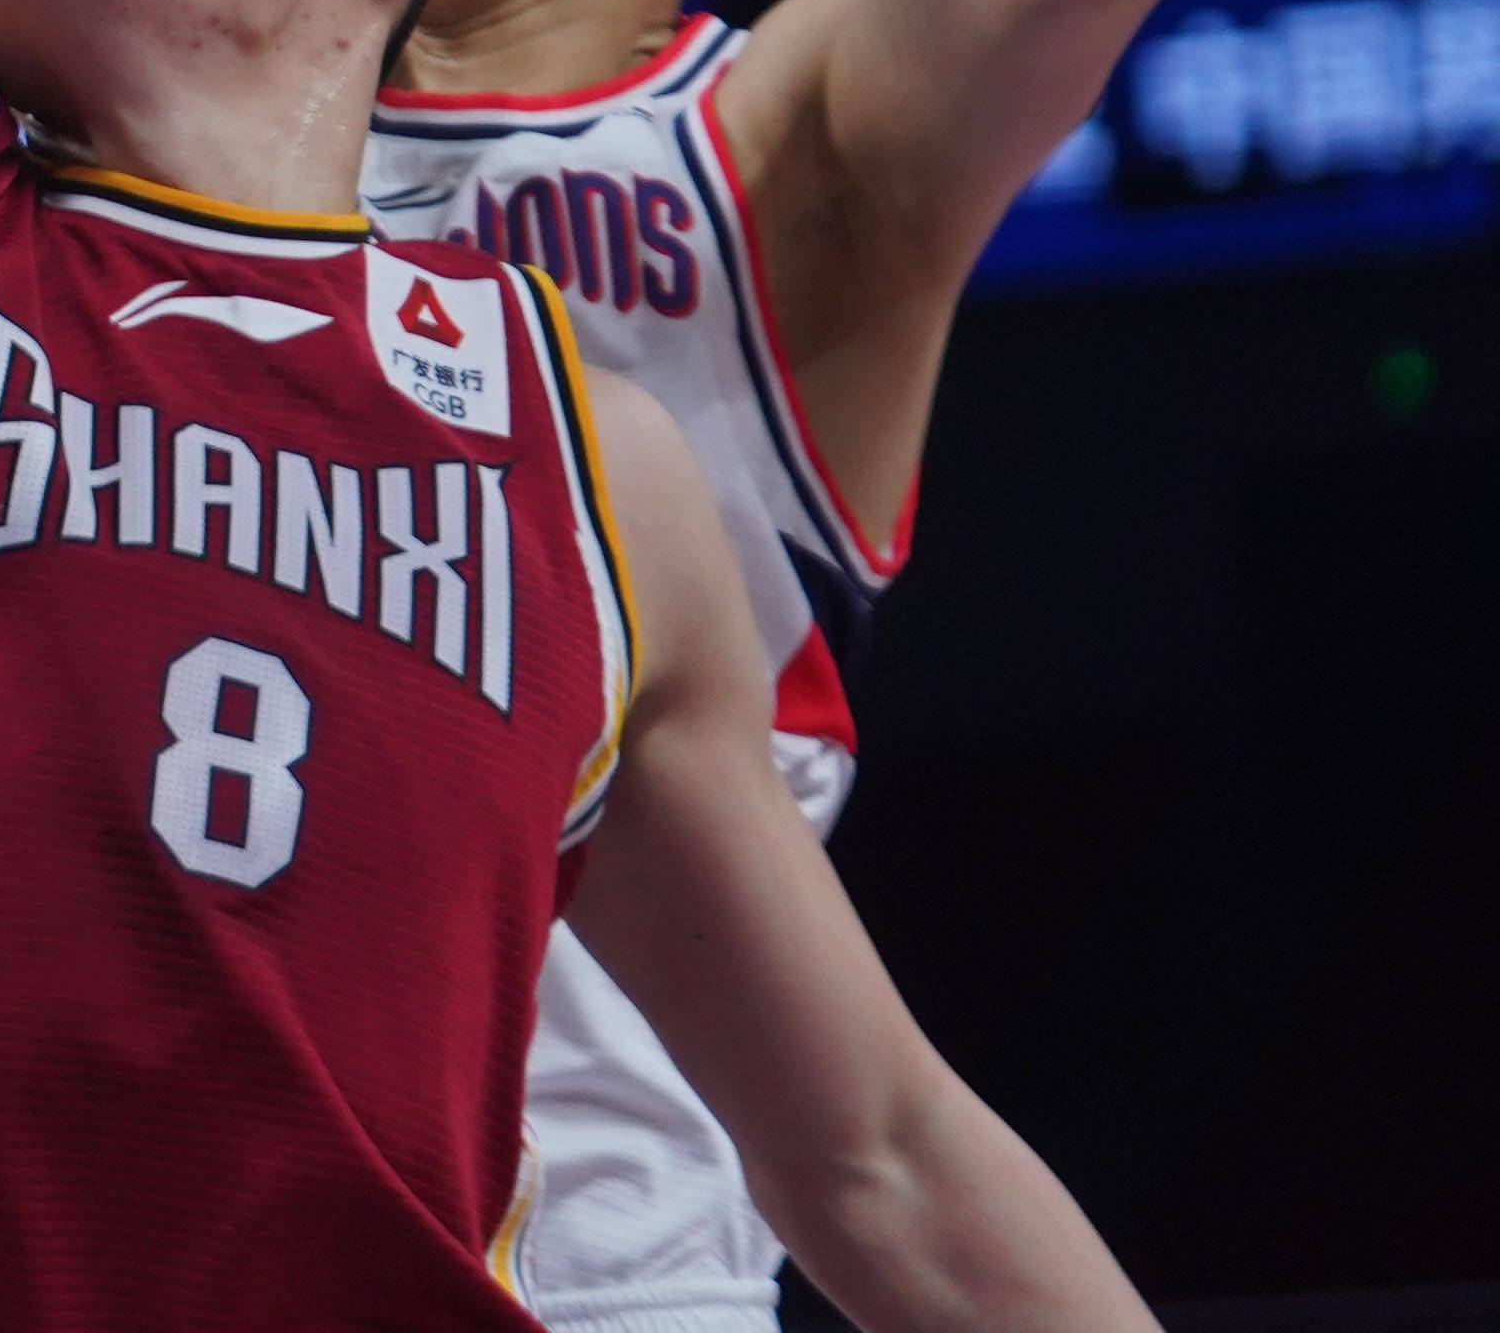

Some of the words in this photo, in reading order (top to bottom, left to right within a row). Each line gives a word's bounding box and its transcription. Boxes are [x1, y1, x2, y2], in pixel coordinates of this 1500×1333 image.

[446, 166, 700, 320] IONS
[390, 347, 487, 393] 广发银行
[413, 382, 468, 419] CGB
[150, 634, 313, 890] 8
